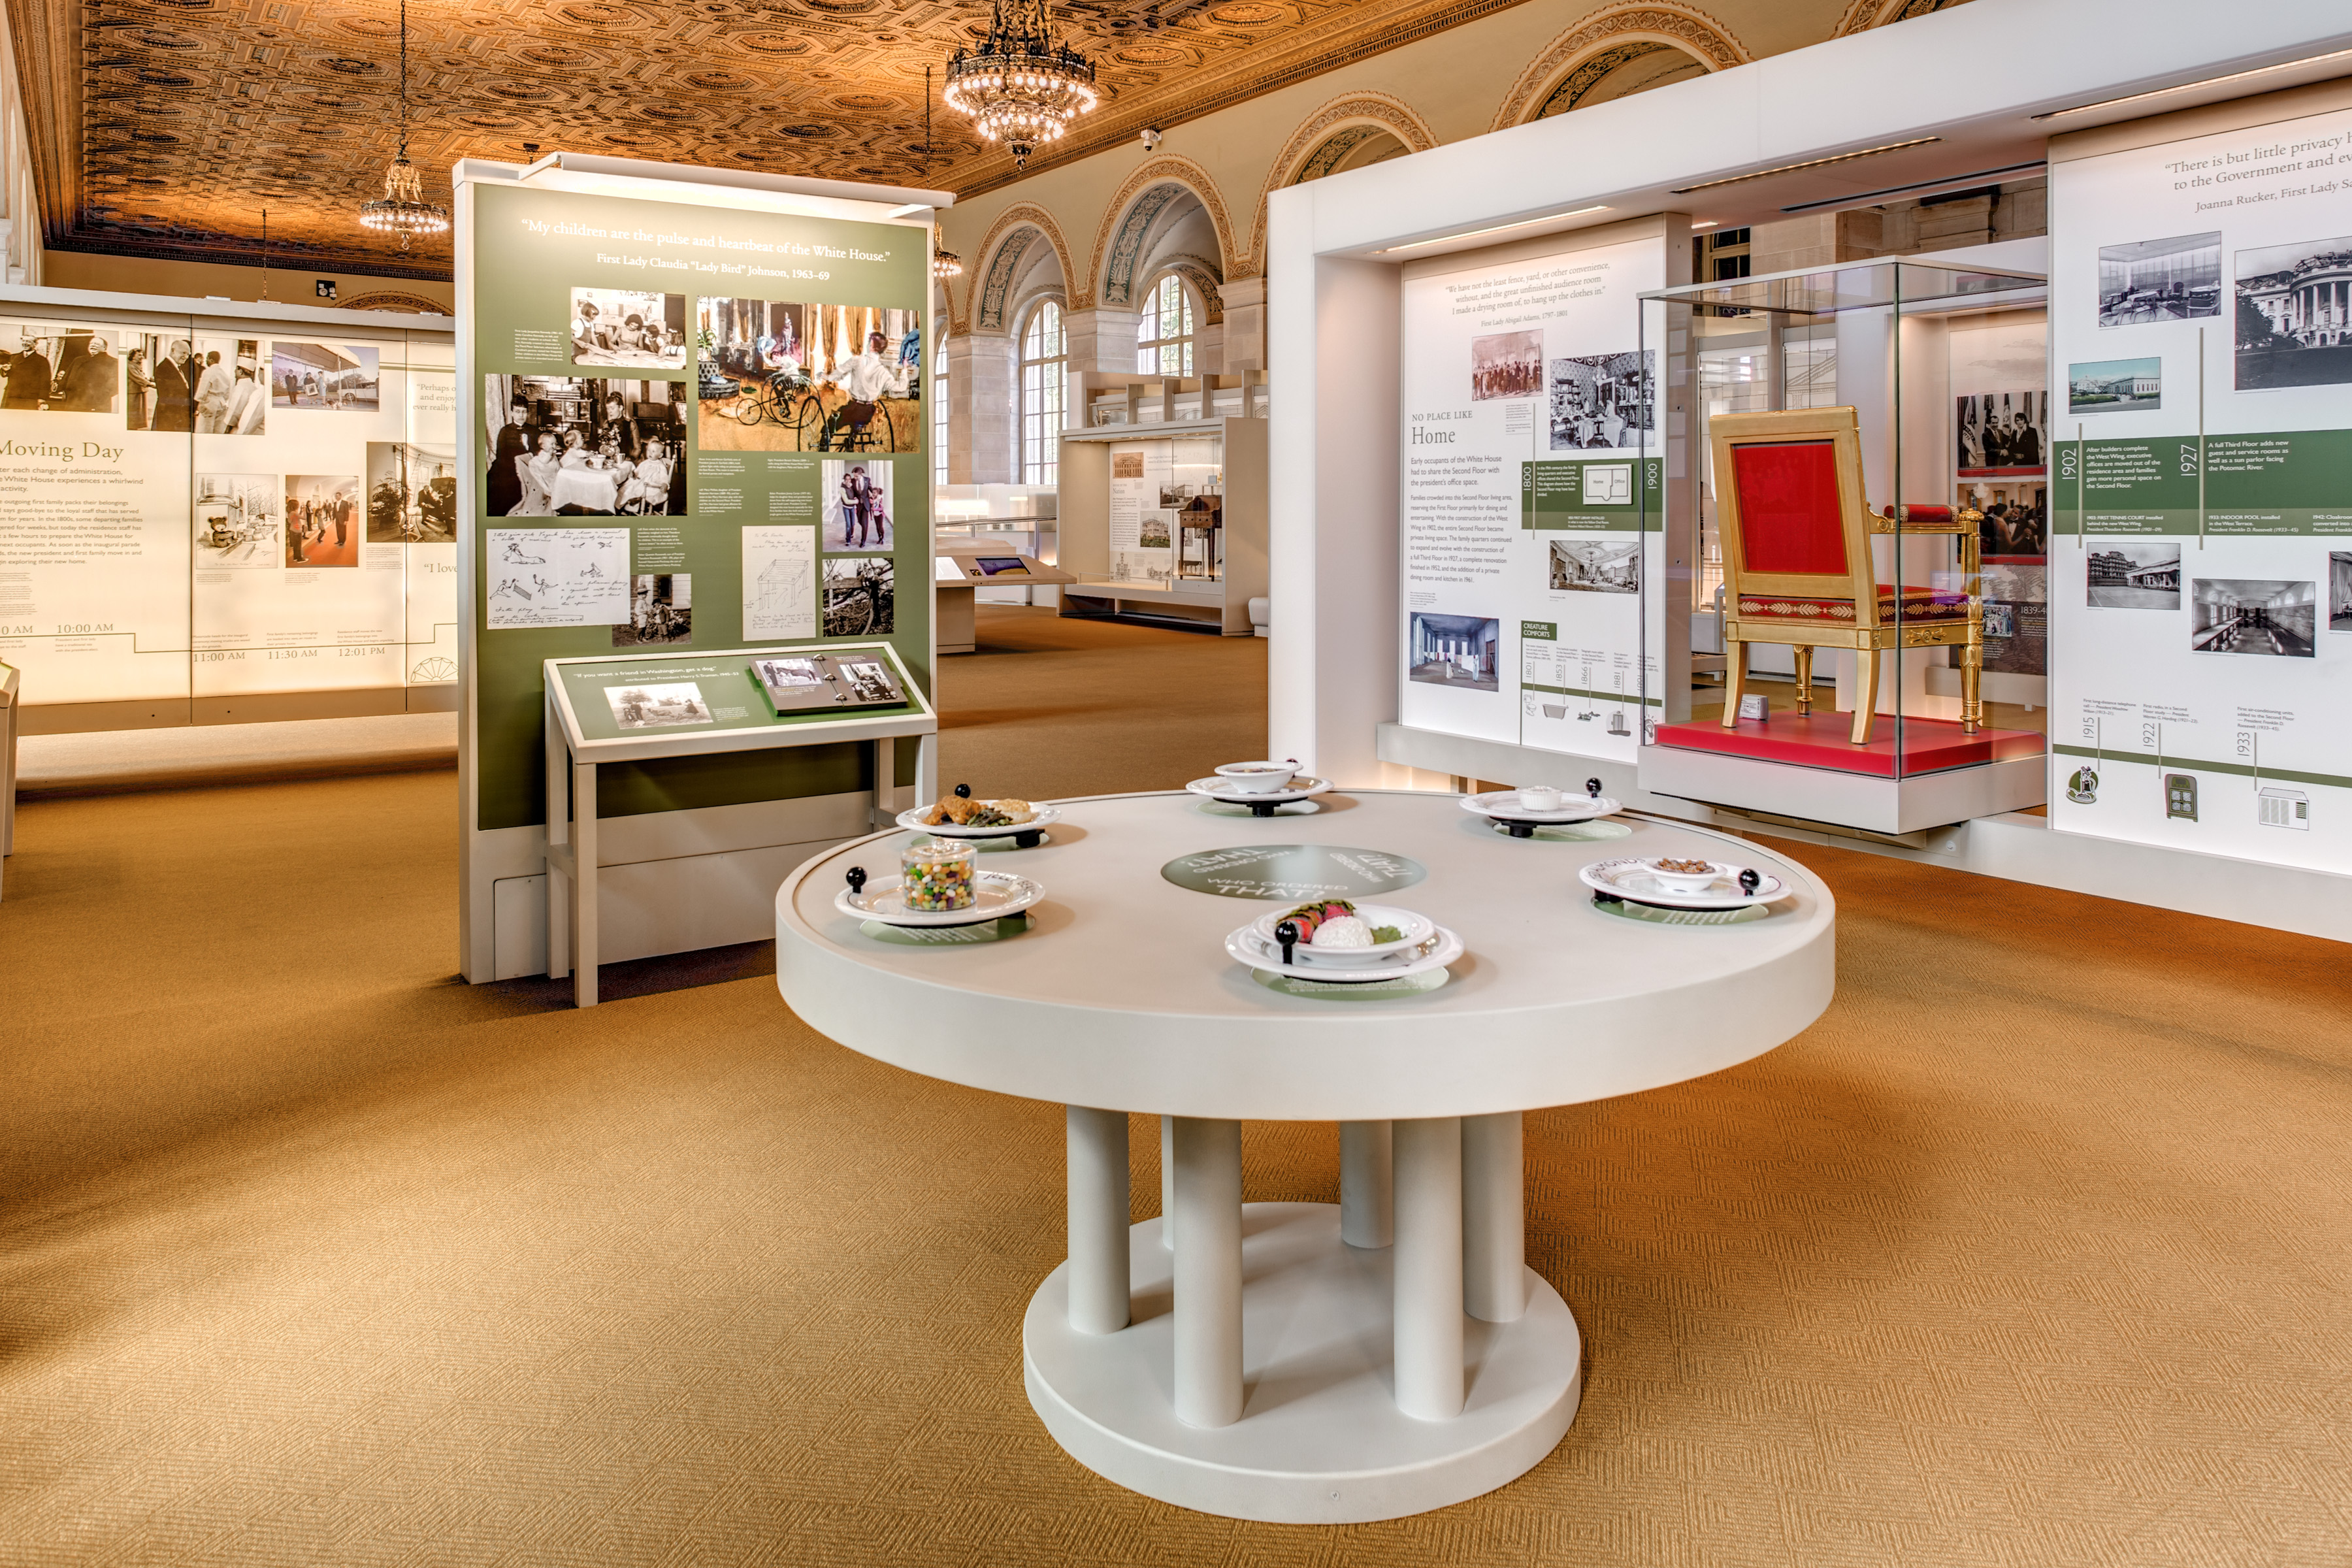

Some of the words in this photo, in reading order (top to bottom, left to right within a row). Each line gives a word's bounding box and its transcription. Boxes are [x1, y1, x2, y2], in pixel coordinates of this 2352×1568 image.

[2212, 155, 2223, 167] is
[2227, 153, 2249, 165] but
[2254, 144, 2286, 160] little
[2291, 137, 2342, 155] privacy
[2174, 182, 2187, 190] to
[2191, 175, 2212, 188] the
[2215, 162, 2302, 183] Government
[2306, 154, 2334, 169] and
[2338, 154, 2352, 163] ev
[2195, 199, 2233, 214] Joanna
[2236, 192, 2278, 205] Rucker,
[2281, 188, 2307, 198] First
[2311, 181, 2338, 193] Lady
[2342, 179, 2352, 189] Sa
[553, 222, 607, 238] children
[611, 229, 630, 240] are
[633, 229, 653, 241] the
[657, 232, 689, 246] pulse
[693, 236, 715, 247] and
[719, 236, 774, 252] heartbeat
[777, 242, 791, 253] of
[792, 243, 810, 255] the
[813, 245, 847, 259] White
[596, 252, 621, 265] First
[623, 255, 648, 269] Lady
[649, 257, 689, 270] Claudia
[690, 261, 719, 275] “Lady
[721, 263, 746, 274] Bird”
[747, 265, 789, 279] Johnson,
[1458, 284, 1471, 292] have
[1482, 280, 1492, 288] the
[1494, 278, 1507, 287] least
[1508, 275, 1525, 284] fence,
[1526, 271, 1541, 284] yard,
[1550, 269, 1568, 278] other
[1569, 263, 1610, 274] convenience,
[1455, 294, 1480, 303] without,
[1480, 290, 1492, 300] and
[1493, 289, 1503, 298] the
[1503, 288, 1519, 298] great
[1520, 282, 1553, 294] unfinished
[1554, 279, 1582, 289] audience
[1583, 276, 1601, 285] room
[1456, 305, 1471, 315] made
[1477, 302, 1496, 313] drying
[1514, 297, 1522, 307] of,
[1531, 295, 1547, 304] hang
[1548, 295, 1557, 303] up
[1558, 291, 1569, 301] the
[1570, 289, 1593, 299] clothes
[1594, 286, 1606, 295] in.”
[1505, 315, 1522, 325] Abigail
[1412, 414, 1424, 422] NO
[1427, 412, 1451, 421] PLACE
[1454, 410, 1473, 419] LIKE
[1412, 426, 1456, 444] Home
[0, 440, 73, 463] Moving
[82, 442, 123, 463] Day
[1411, 457, 1423, 466] Early
[2181, 445, 2197, 476] 1927
[1452, 466, 1471, 475] Second
[1472, 466, 1486, 474] Floor
[1648, 463, 1658, 489] 1900
[2062, 449, 2077, 480] 1902
[1447, 478, 1462, 486] office
[1523, 466, 1531, 491] 1800
[2021, 606, 2047, 614] 1839-4
[1523, 629, 1550, 638] COMFORTS
[2083, 717, 2094, 738] 1915
[2143, 723, 2155, 747] 1922
[2237, 732, 2249, 757] 1933
[1217, 885, 1326, 898] THAT?
[1260, 881, 1348, 890] ORDERED
